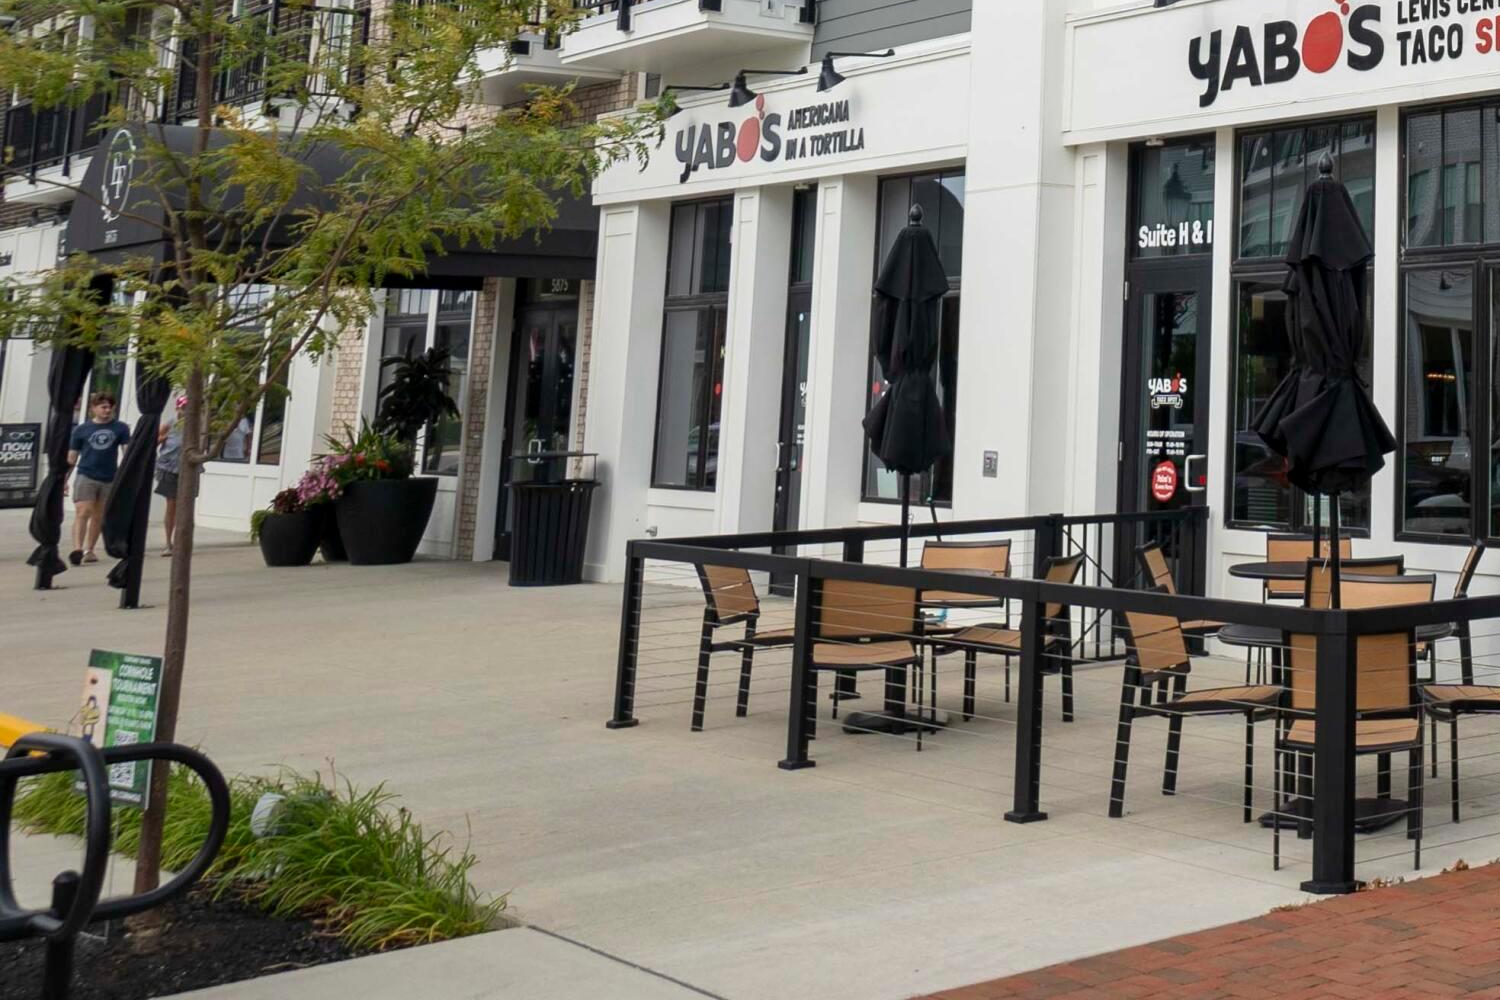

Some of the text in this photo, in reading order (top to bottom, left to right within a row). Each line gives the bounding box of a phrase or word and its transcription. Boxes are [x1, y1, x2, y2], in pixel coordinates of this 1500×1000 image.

[1396, 23, 1464, 67] TACO
[787, 99, 850, 131] AMERICANA
[785, 127, 865, 161] IN A TORTILLA
[1138, 223, 1177, 248] Suite
[1178, 221, 1189, 246] H
[1191, 219, 1204, 245] &
[2, 441, 33, 452] now
